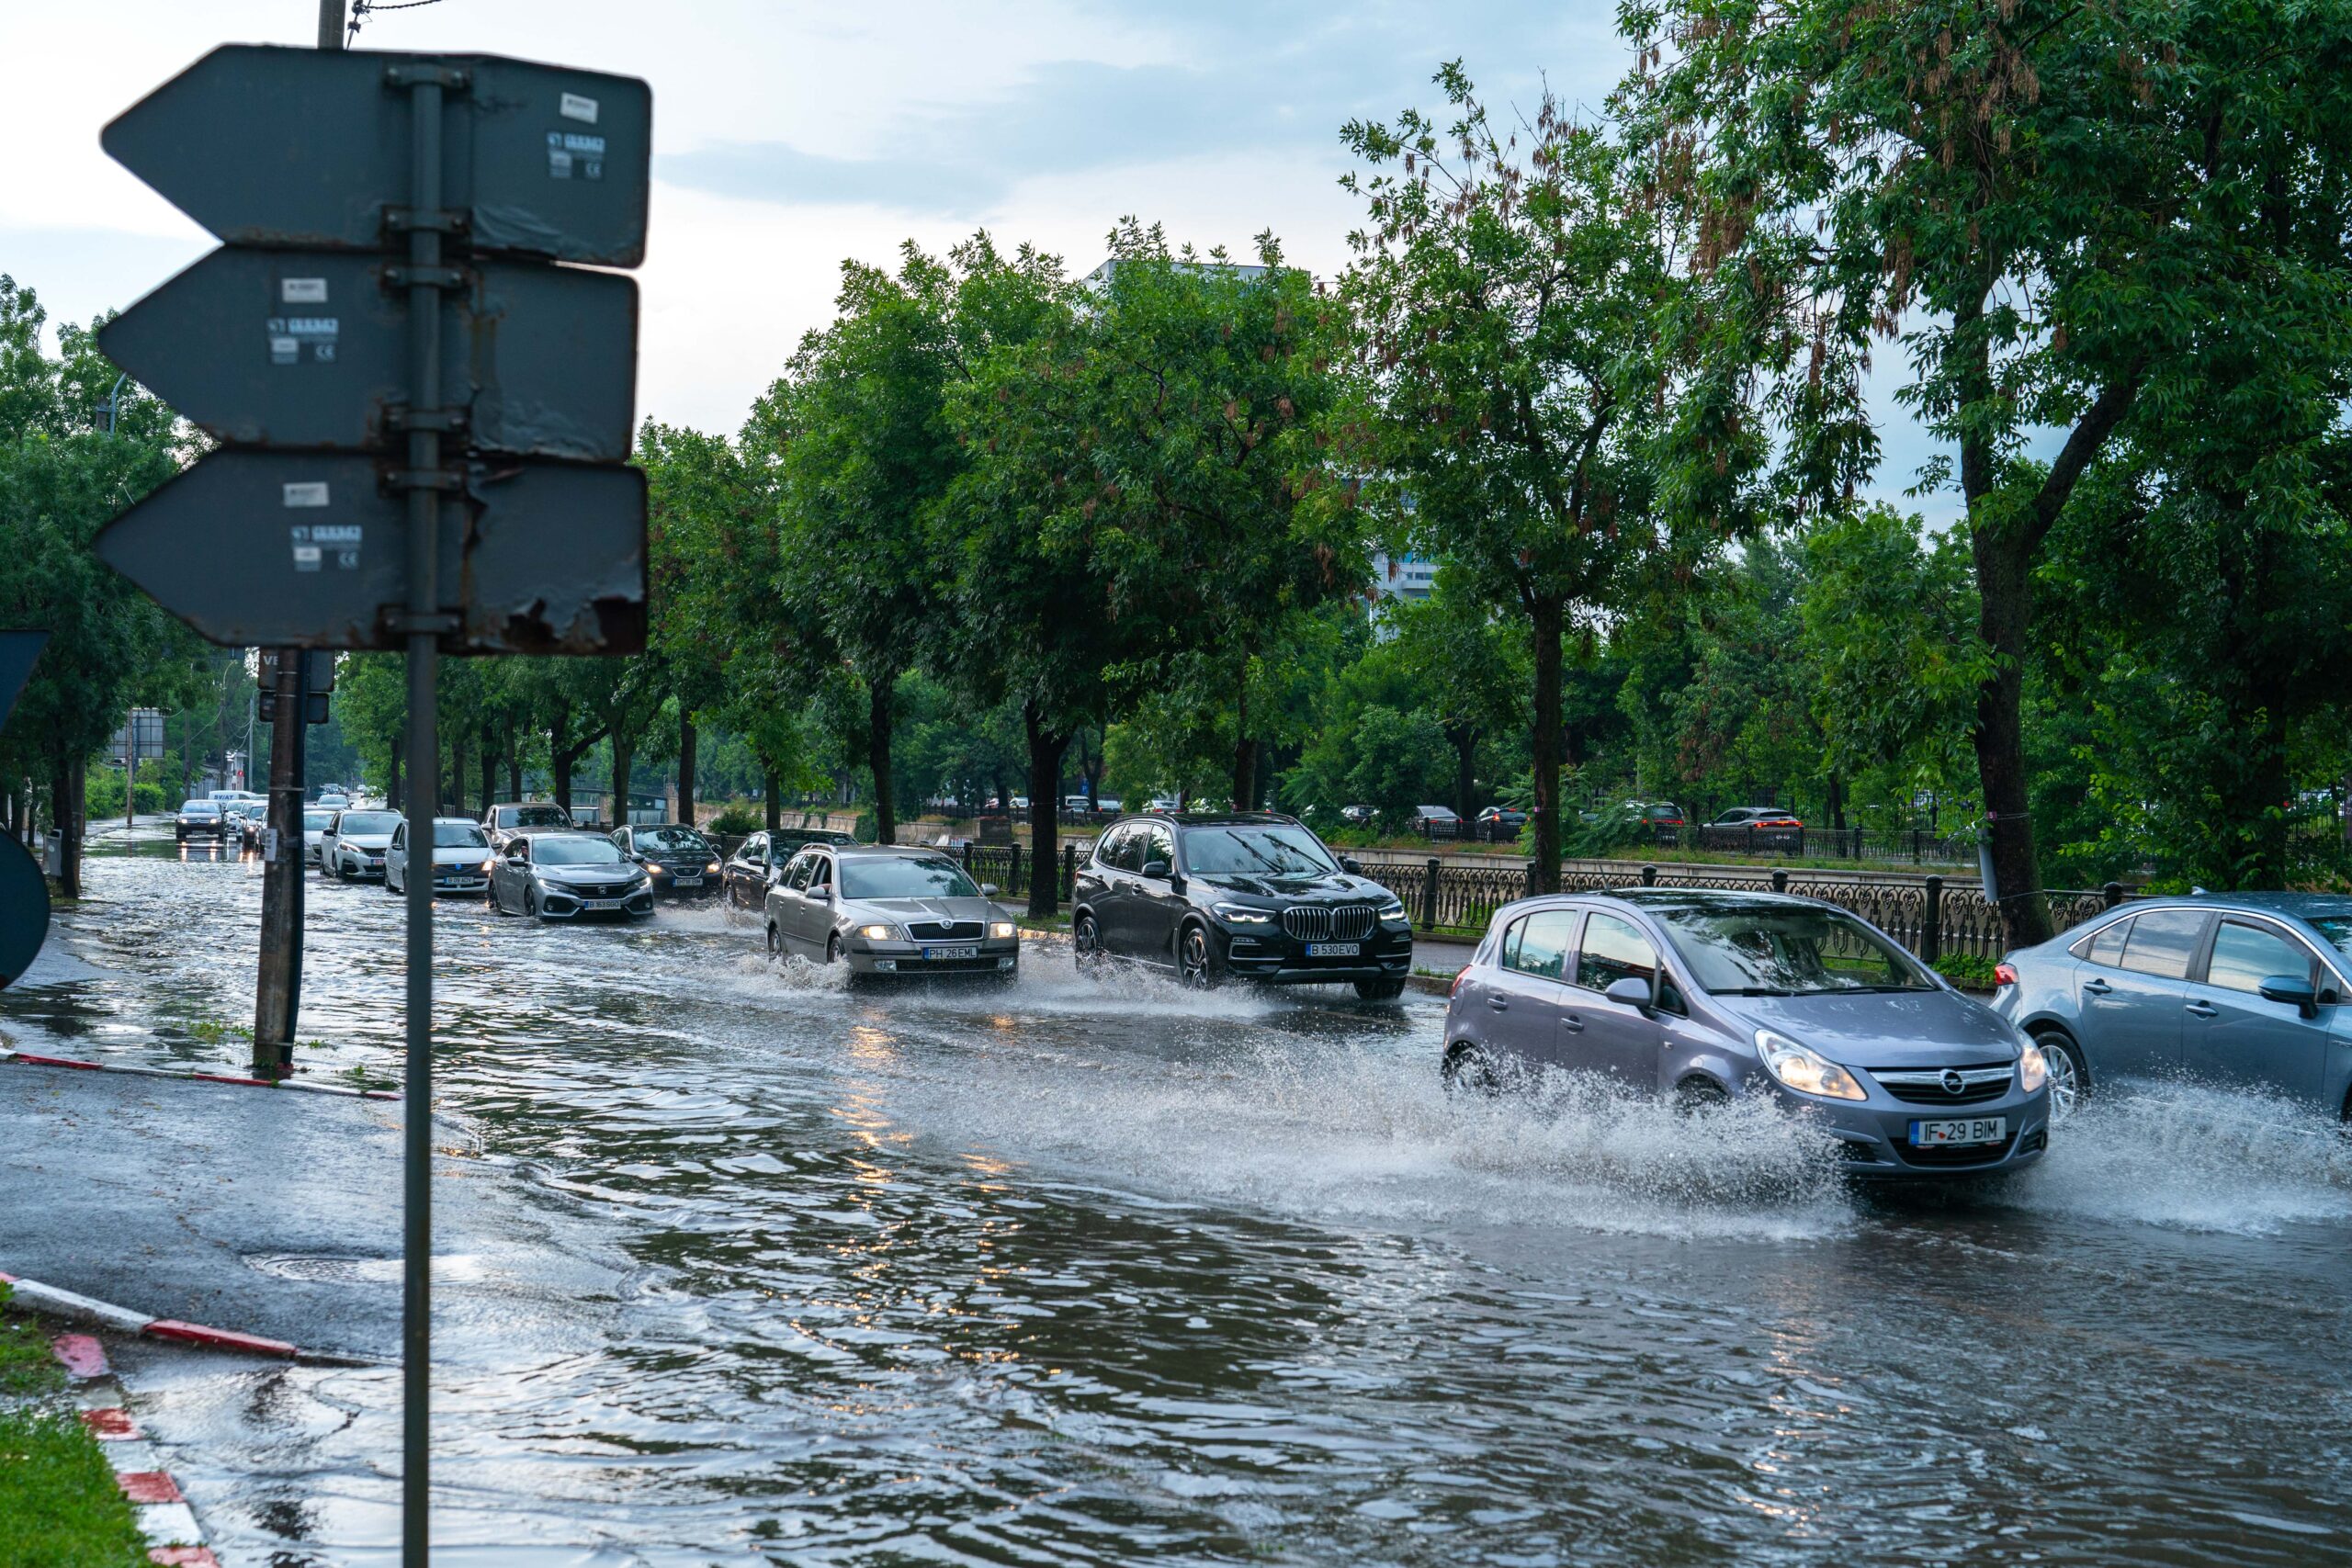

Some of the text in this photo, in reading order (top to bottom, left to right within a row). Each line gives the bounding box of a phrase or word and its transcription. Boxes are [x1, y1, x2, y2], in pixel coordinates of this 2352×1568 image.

[589, 900, 595, 908] B
[929, 949, 944, 958] PH
[1311, 944, 1319, 955] B
[1924, 1120, 1998, 1141] IF 29 BIM
